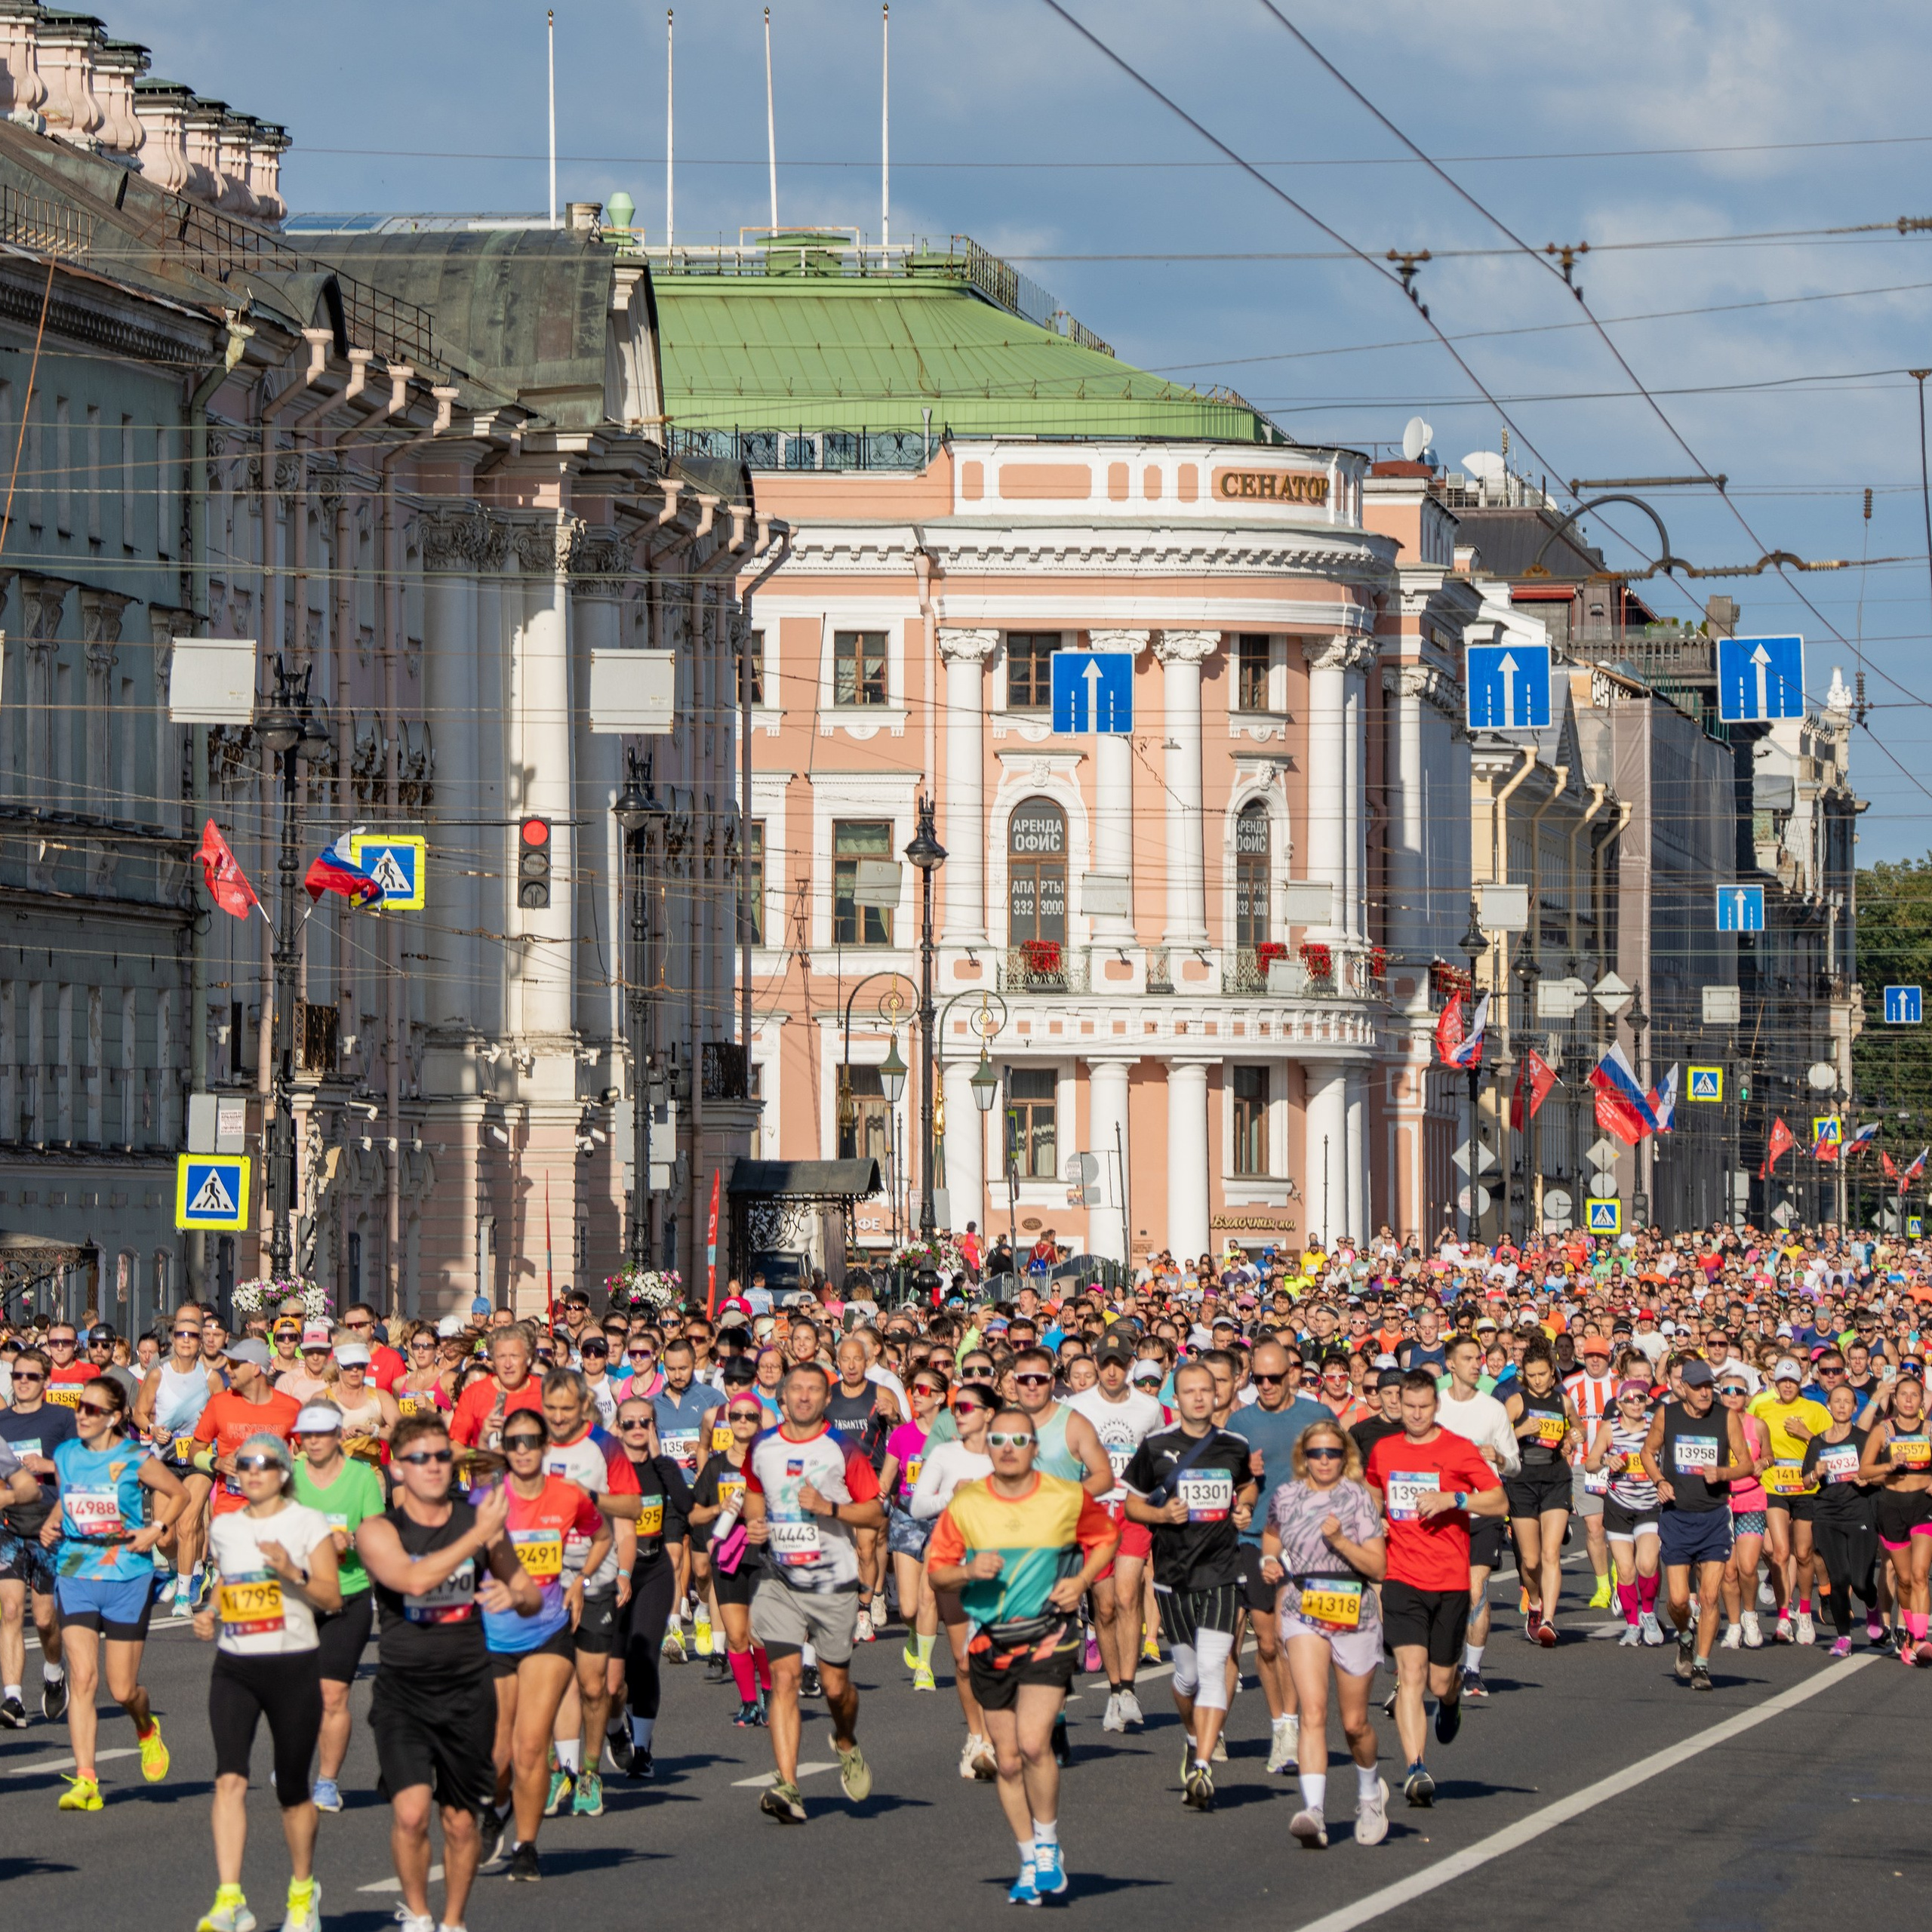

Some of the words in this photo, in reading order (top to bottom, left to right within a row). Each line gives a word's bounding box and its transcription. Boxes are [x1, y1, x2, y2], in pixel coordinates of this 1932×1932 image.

[1220, 472, 1330, 504] СЕНАТОР
[1013, 819, 1063, 834] АРЕНДА
[1015, 834, 1060, 851] ОФИС
[1238, 835, 1266, 852] ОФИС
[1014, 900, 1033, 915] 332
[1041, 900, 1064, 915] 3000
[1254, 901, 1268, 916] 3000
[48, 1392, 84, 1402] 13587
[663, 1441, 685, 1454] 135
[1678, 1447, 1715, 1460] 13958
[1827, 1457, 1857, 1470] 4932
[1183, 1484, 1228, 1500] 13301
[67, 1500, 116, 1517] 14988
[1394, 1510, 1401, 1518] D
[771, 1527, 816, 1542] 14443
[516, 1546, 557, 1564] 2491
[223, 1584, 279, 1610] 11795
[1307, 1595, 1357, 1614] 11318
